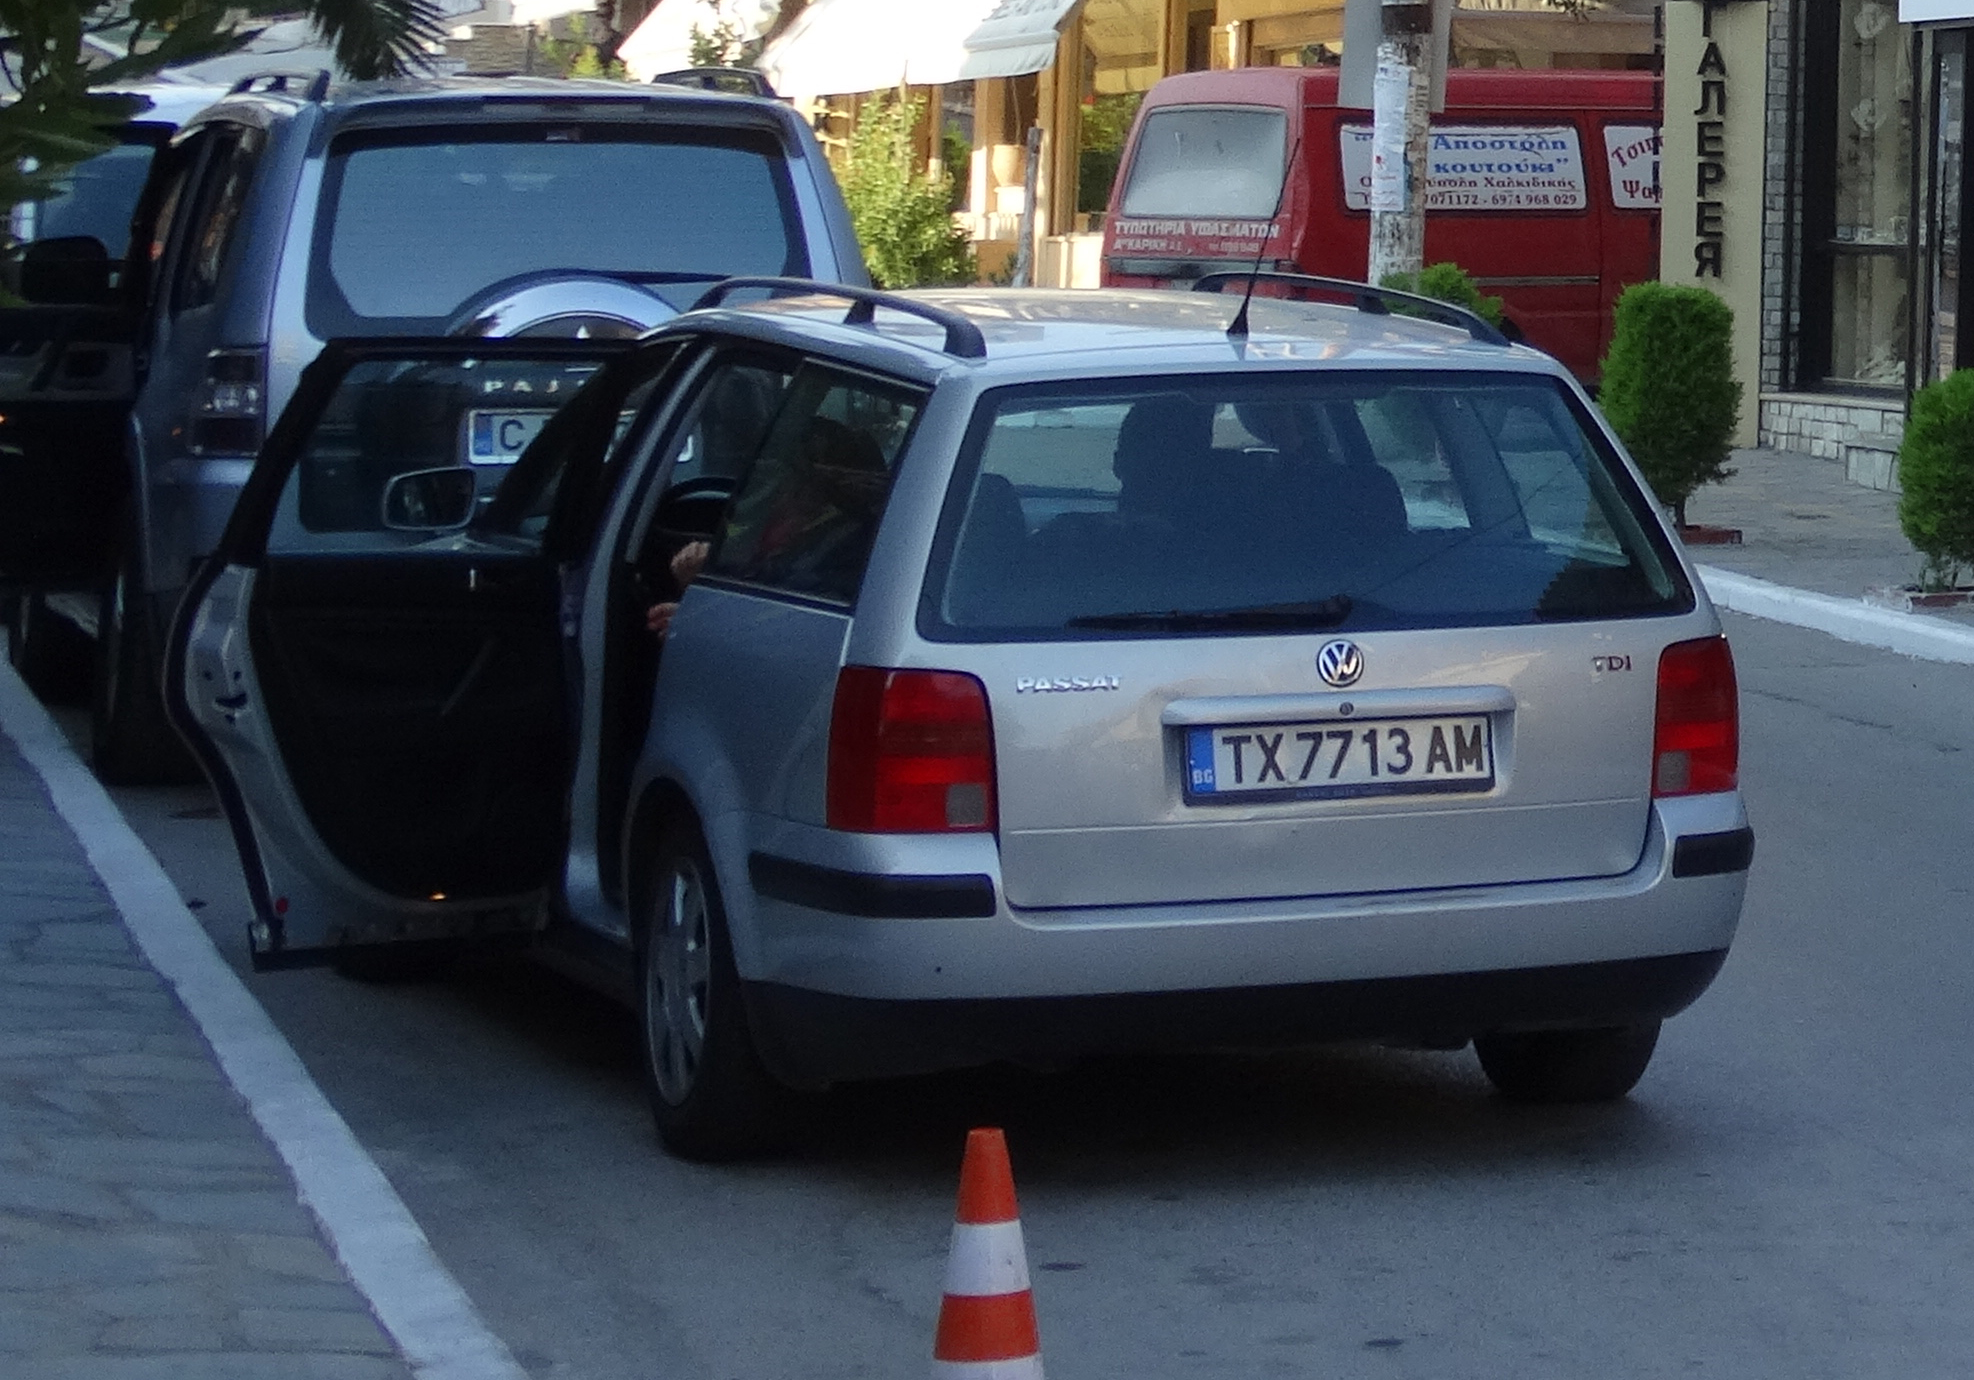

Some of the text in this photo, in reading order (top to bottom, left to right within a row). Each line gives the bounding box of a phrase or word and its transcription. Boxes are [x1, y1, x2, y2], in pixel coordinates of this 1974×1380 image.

[1484, 177, 1576, 190] Χαλκιδικής
[1491, 194, 1521, 205] 6974
[1526, 194, 1550, 205] 968
[1554, 194, 1577, 205] 029
[1592, 654, 1632, 672] TDI
[1016, 674, 1122, 693] PASSAT
[1222, 724, 1484, 785] TX 7713 AM
[1192, 769, 1213, 784] BG
